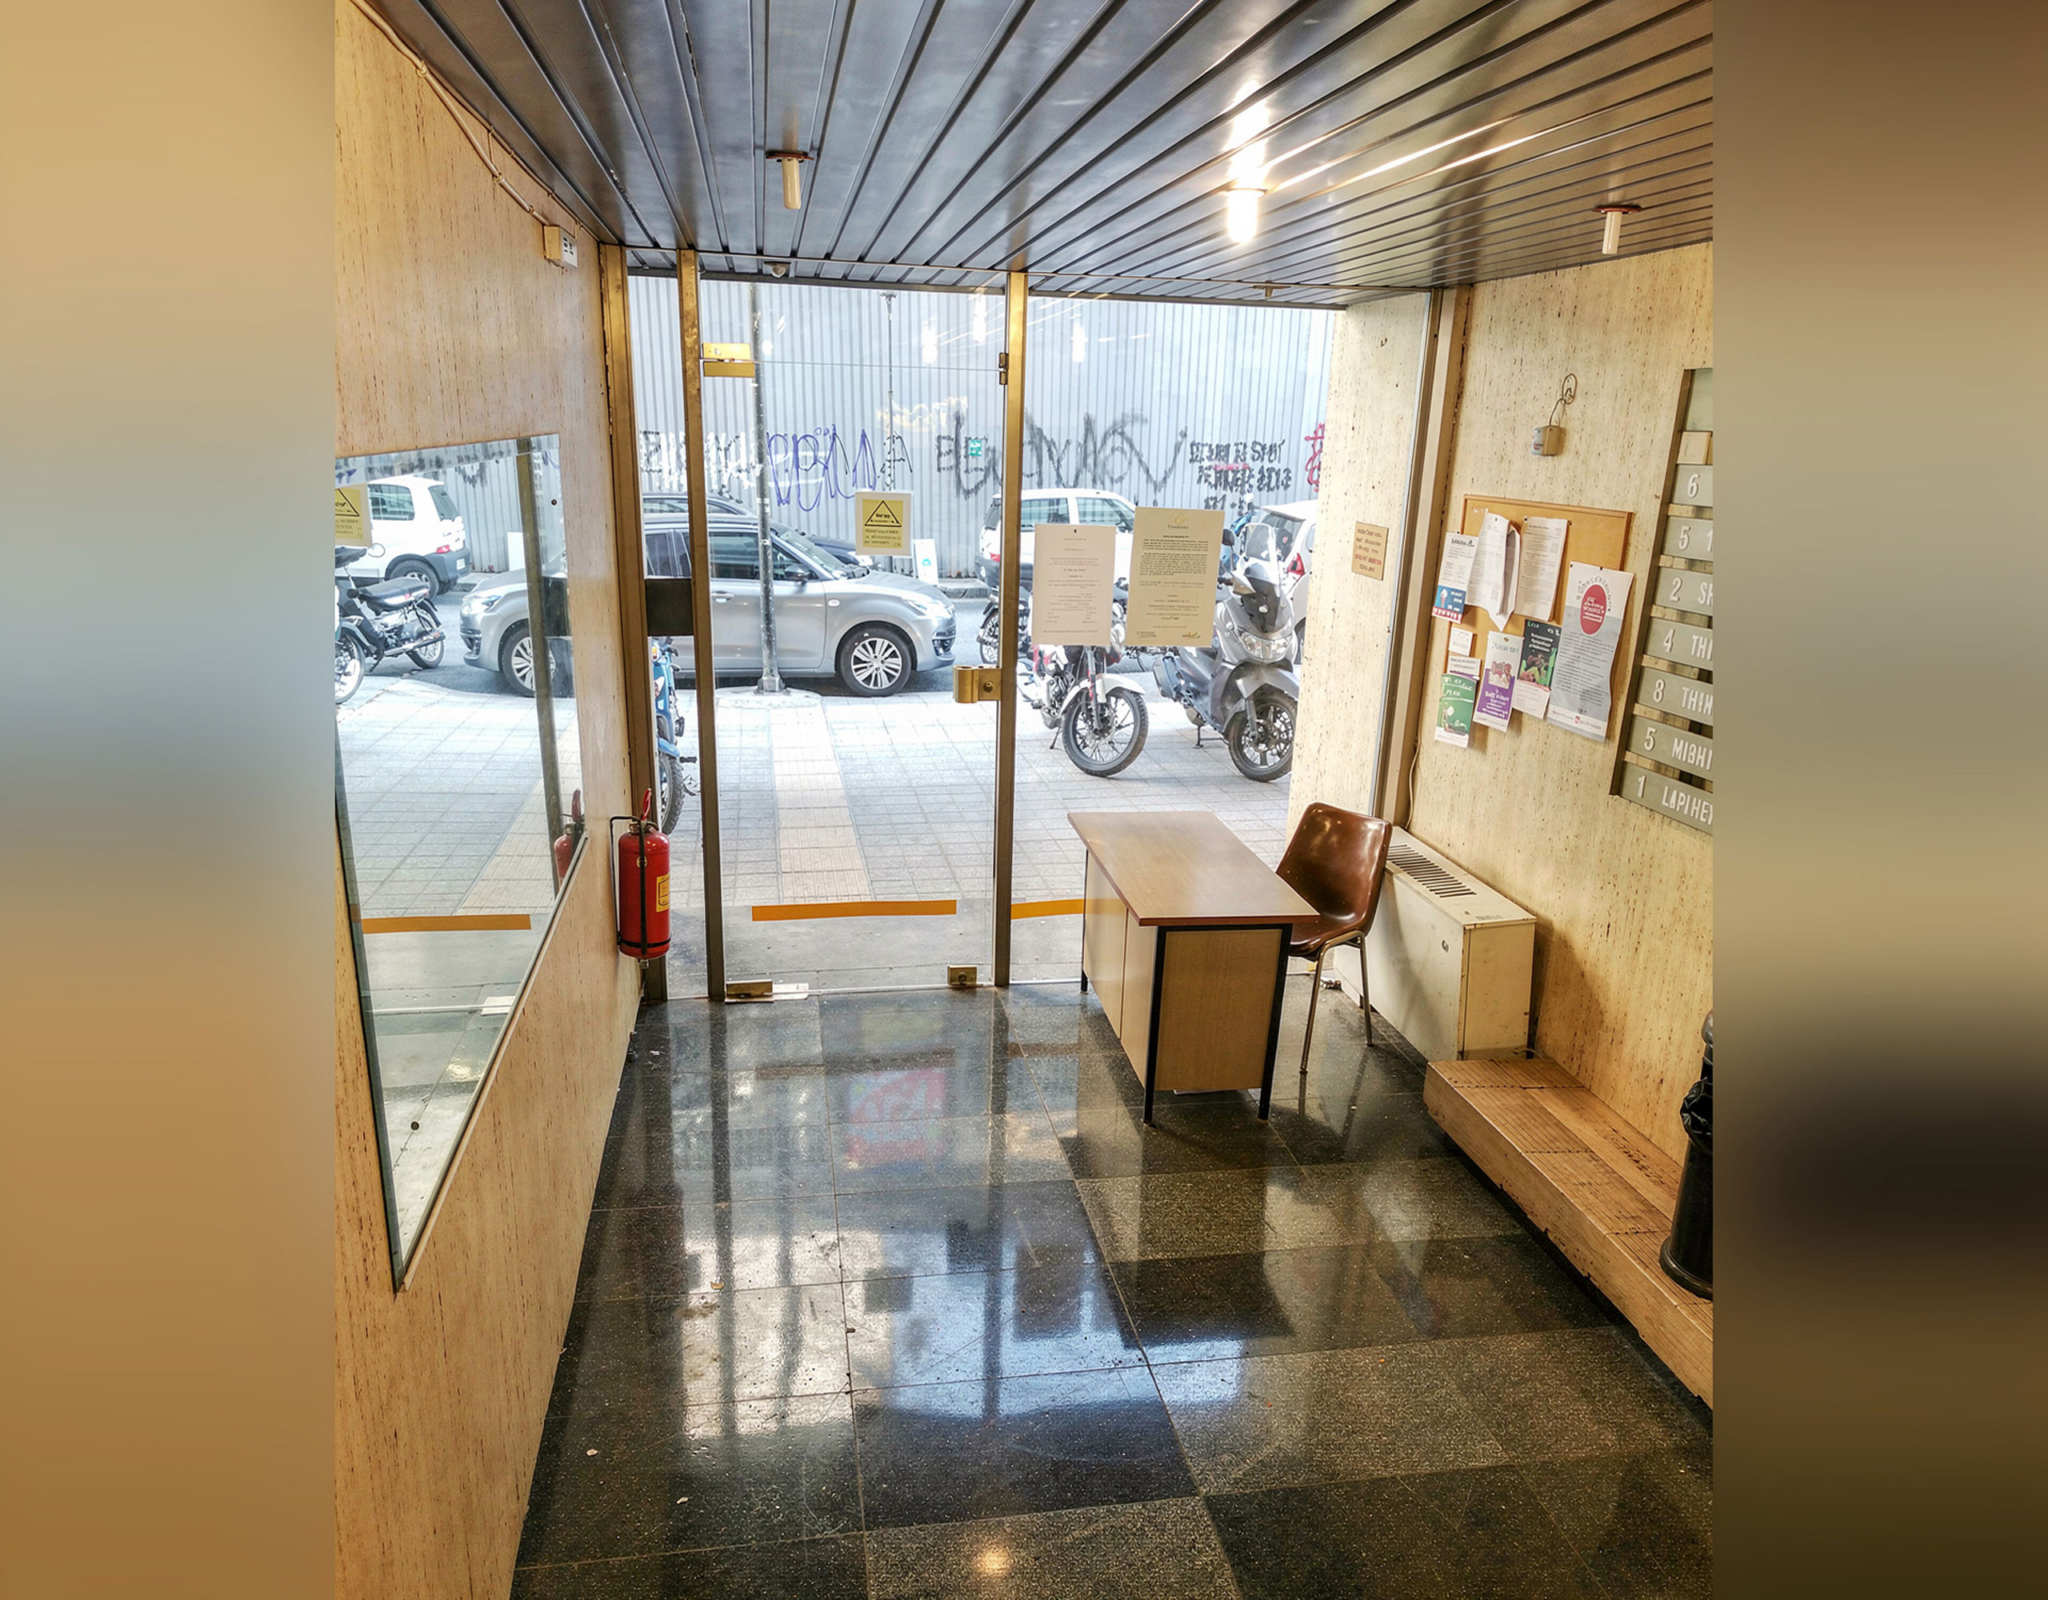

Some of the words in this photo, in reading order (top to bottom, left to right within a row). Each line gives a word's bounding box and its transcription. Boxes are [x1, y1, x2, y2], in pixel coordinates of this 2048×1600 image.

[1687, 473, 1699, 498] 6
[1678, 525, 1690, 550] 5
[1669, 577, 1683, 602] 2
[1663, 628, 1675, 653] 4
[1653, 679, 1665, 703] 8
[1644, 726, 1656, 751] 5
[1638, 775, 1646, 798] 1
